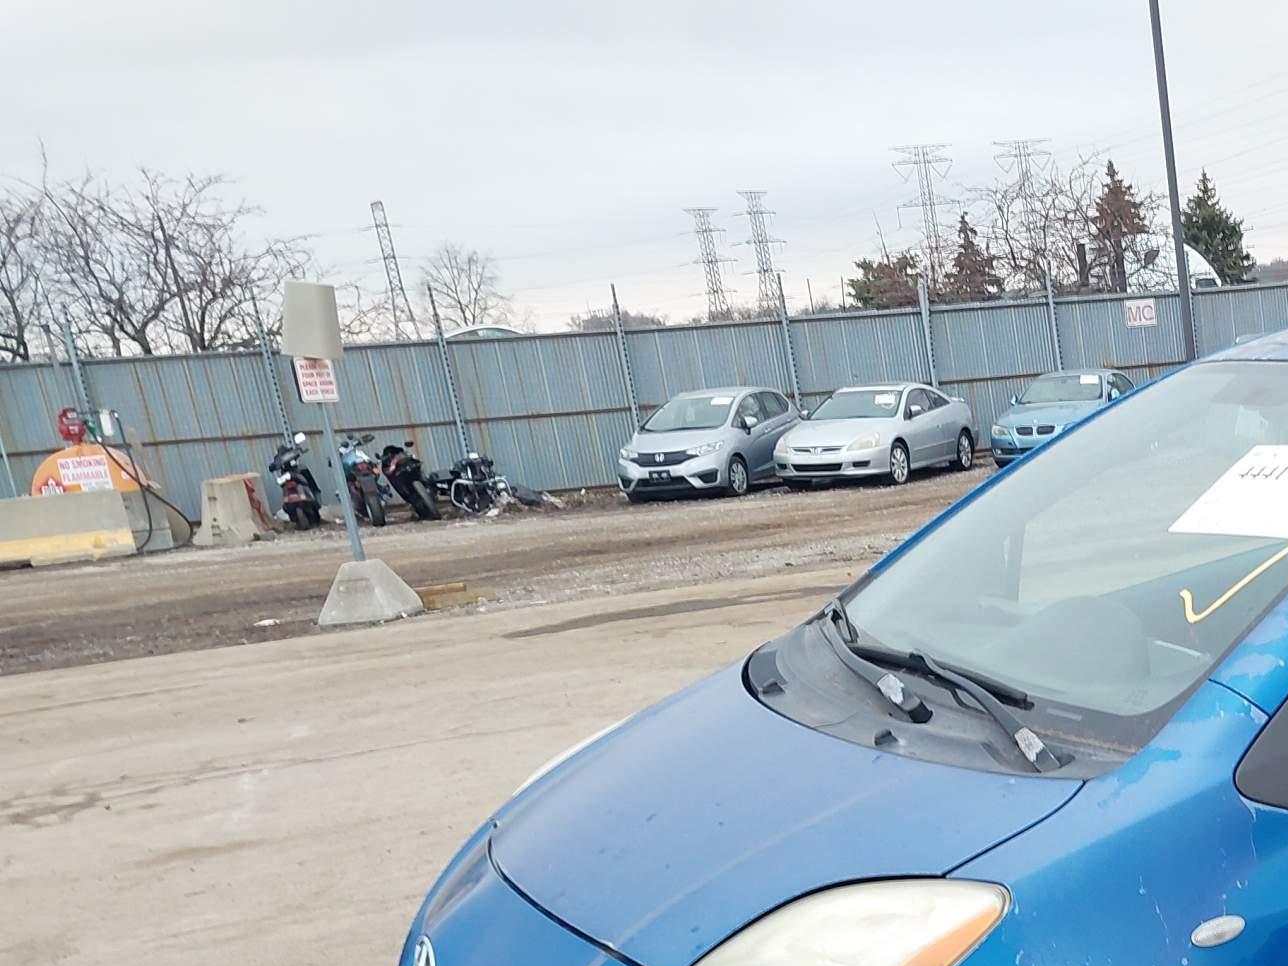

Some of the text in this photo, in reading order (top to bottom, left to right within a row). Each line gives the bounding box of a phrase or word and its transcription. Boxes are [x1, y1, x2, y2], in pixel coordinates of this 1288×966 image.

[59, 458, 106, 470] NO SMOKING
[63, 470, 108, 483] FLAMMABLE
